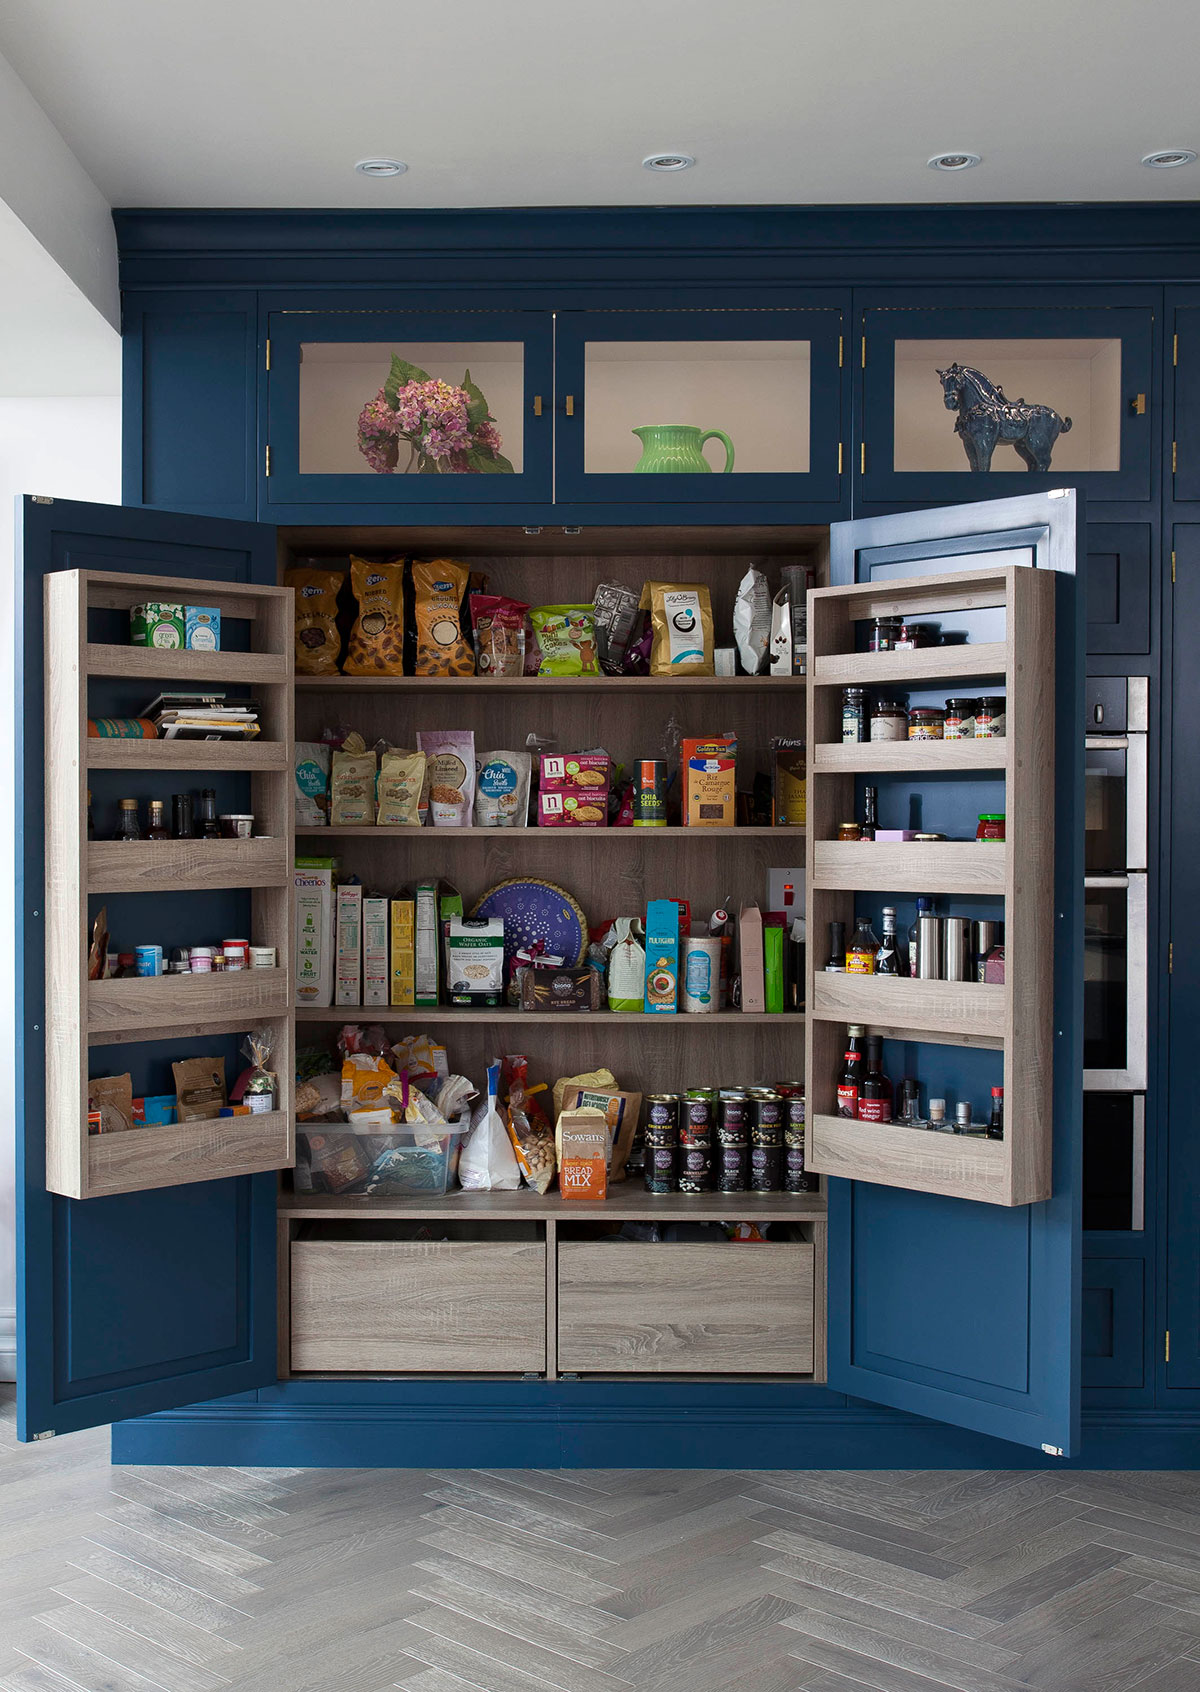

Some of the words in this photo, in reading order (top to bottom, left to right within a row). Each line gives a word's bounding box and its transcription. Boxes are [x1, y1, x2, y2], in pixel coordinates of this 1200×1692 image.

[366, 573, 388, 585] gem
[301, 587, 324, 597] gem
[364, 588, 387, 597] NIBBED
[432, 582, 454, 592] gem
[777, 738, 801, 749] Thins
[296, 768, 317, 780] Chia
[482, 768, 506, 780] Chia
[698, 780, 730, 788] Camargue
[562, 1131, 605, 1142] Sowans
[564, 1166, 593, 1174] BREAD
[564, 1174, 591, 1186] MIX
